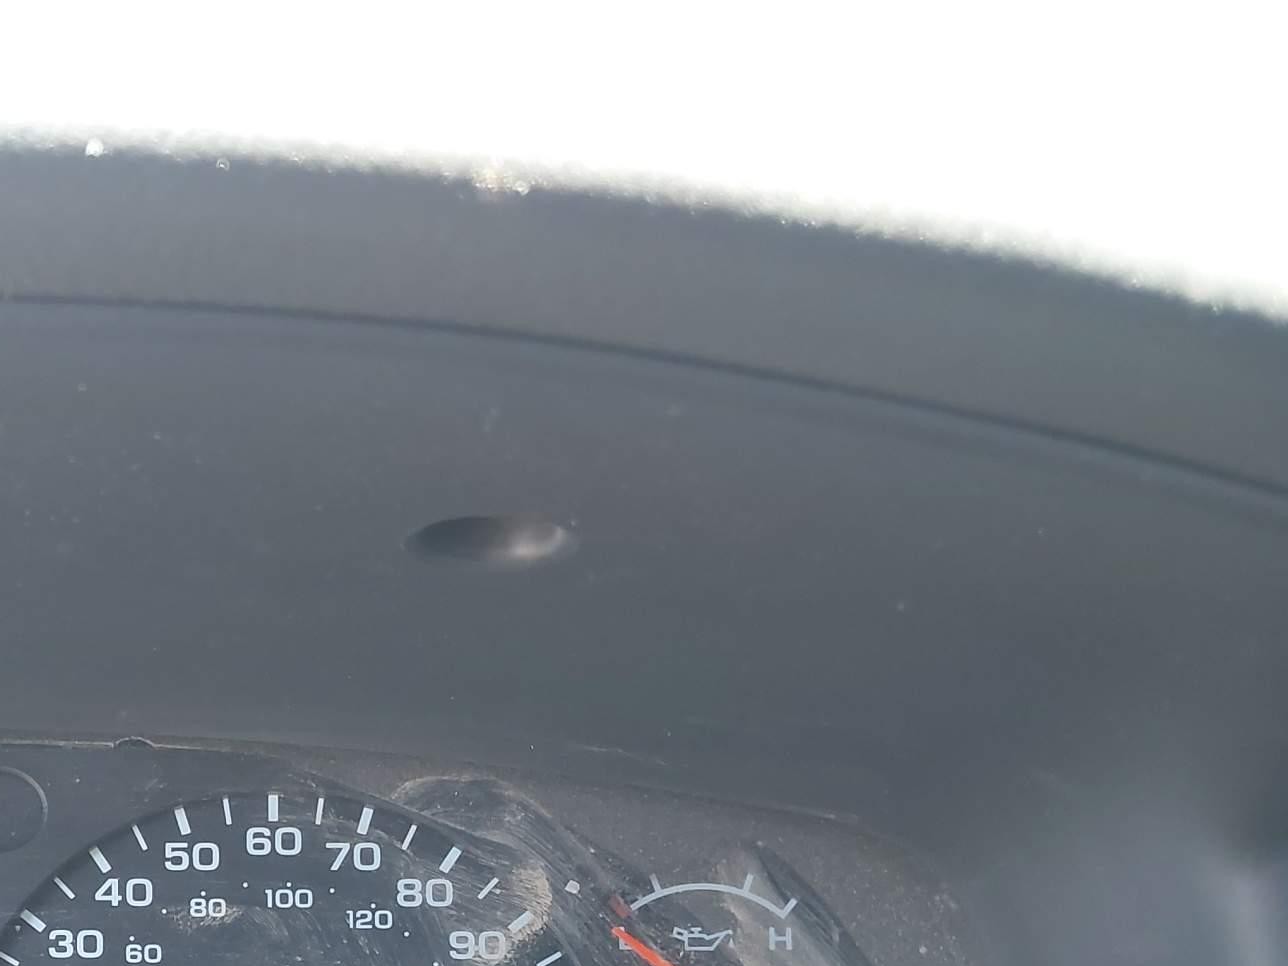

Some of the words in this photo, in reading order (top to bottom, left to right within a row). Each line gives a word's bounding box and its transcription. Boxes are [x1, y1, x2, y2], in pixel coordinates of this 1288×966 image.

[245, 826, 303, 856] 60
[164, 842, 220, 871] 50
[326, 842, 381, 871] 70
[94, 878, 153, 906] 40
[265, 888, 312, 909] 100
[396, 879, 453, 907] 80
[189, 898, 226, 919] 80
[348, 910, 393, 930] 120
[48, 929, 104, 958] 30
[448, 931, 506, 961] 90
[769, 927, 793, 950] H
[125, 944, 162, 964] 60
